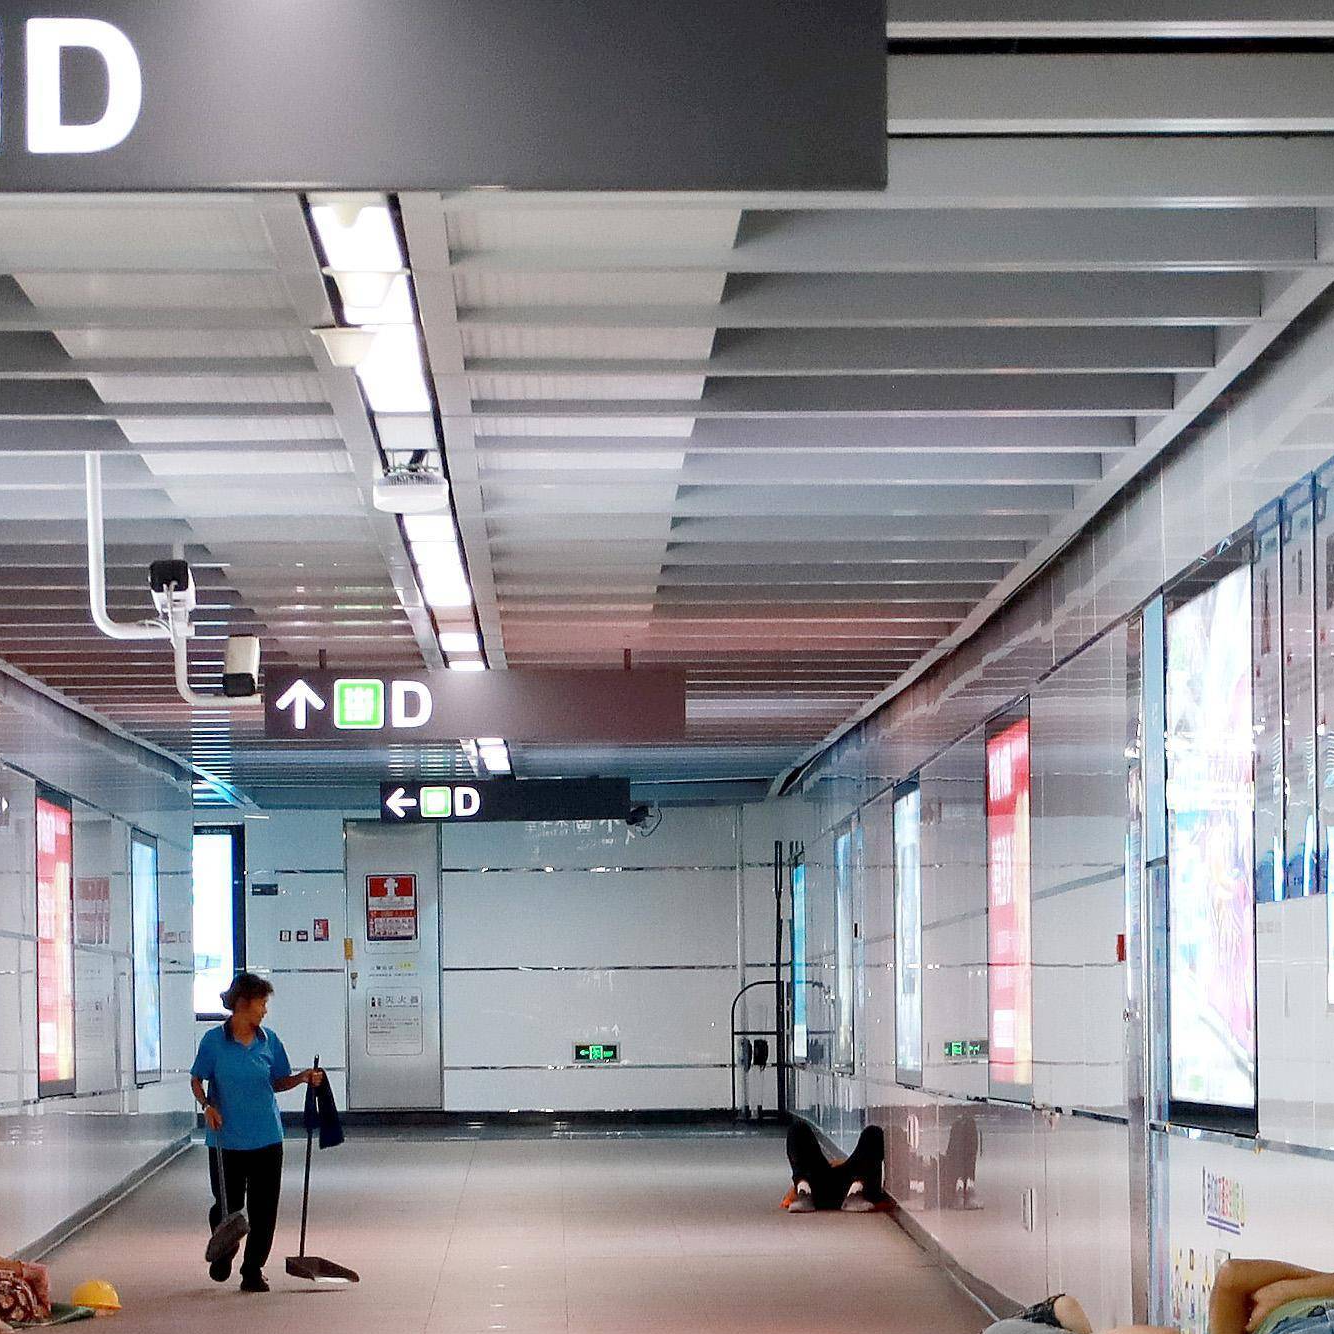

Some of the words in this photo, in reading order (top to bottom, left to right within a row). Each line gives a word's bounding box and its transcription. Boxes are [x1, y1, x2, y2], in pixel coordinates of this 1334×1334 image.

[25, 17, 142, 154] D
[391, 680, 434, 728] D
[454, 786, 481, 818] D
